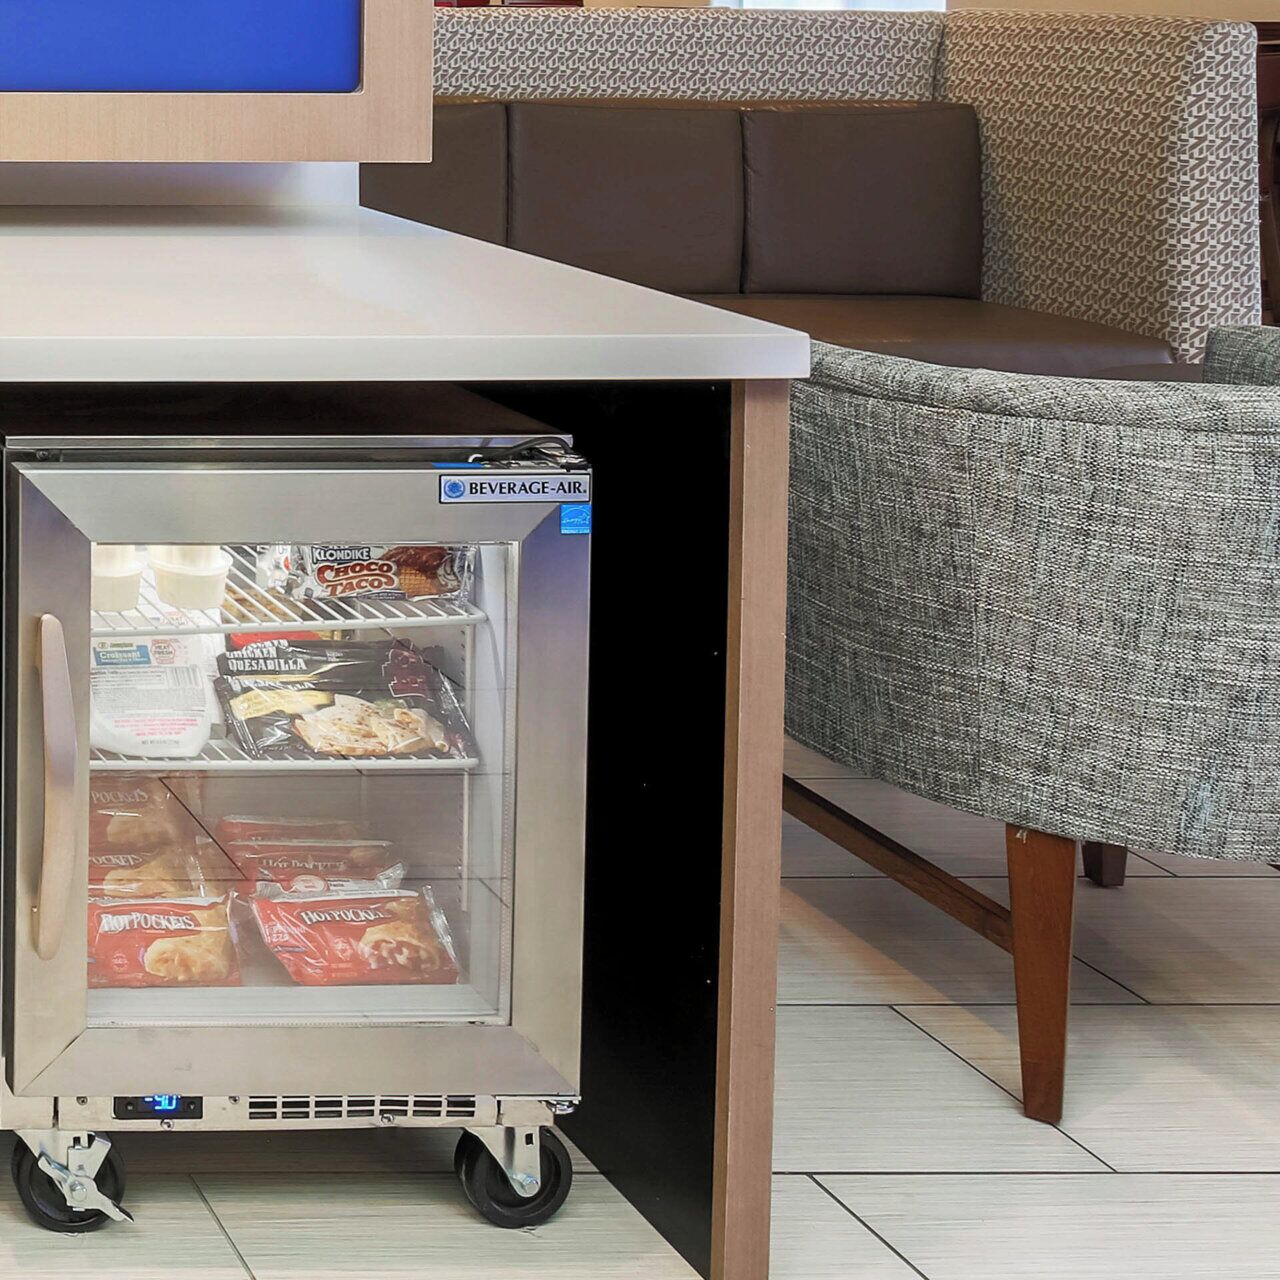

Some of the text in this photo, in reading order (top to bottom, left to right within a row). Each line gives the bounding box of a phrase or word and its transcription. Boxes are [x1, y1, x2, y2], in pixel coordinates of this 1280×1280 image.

[469, 481, 583, 495] BEVERAGE-AIR
[312, 546, 371, 563] KLONDIKE
[316, 560, 395, 586] CHOCO
[325, 578, 384, 598] TACO
[99, 650, 142, 660] Croissant
[228, 658, 308, 671] QUESADILLA
